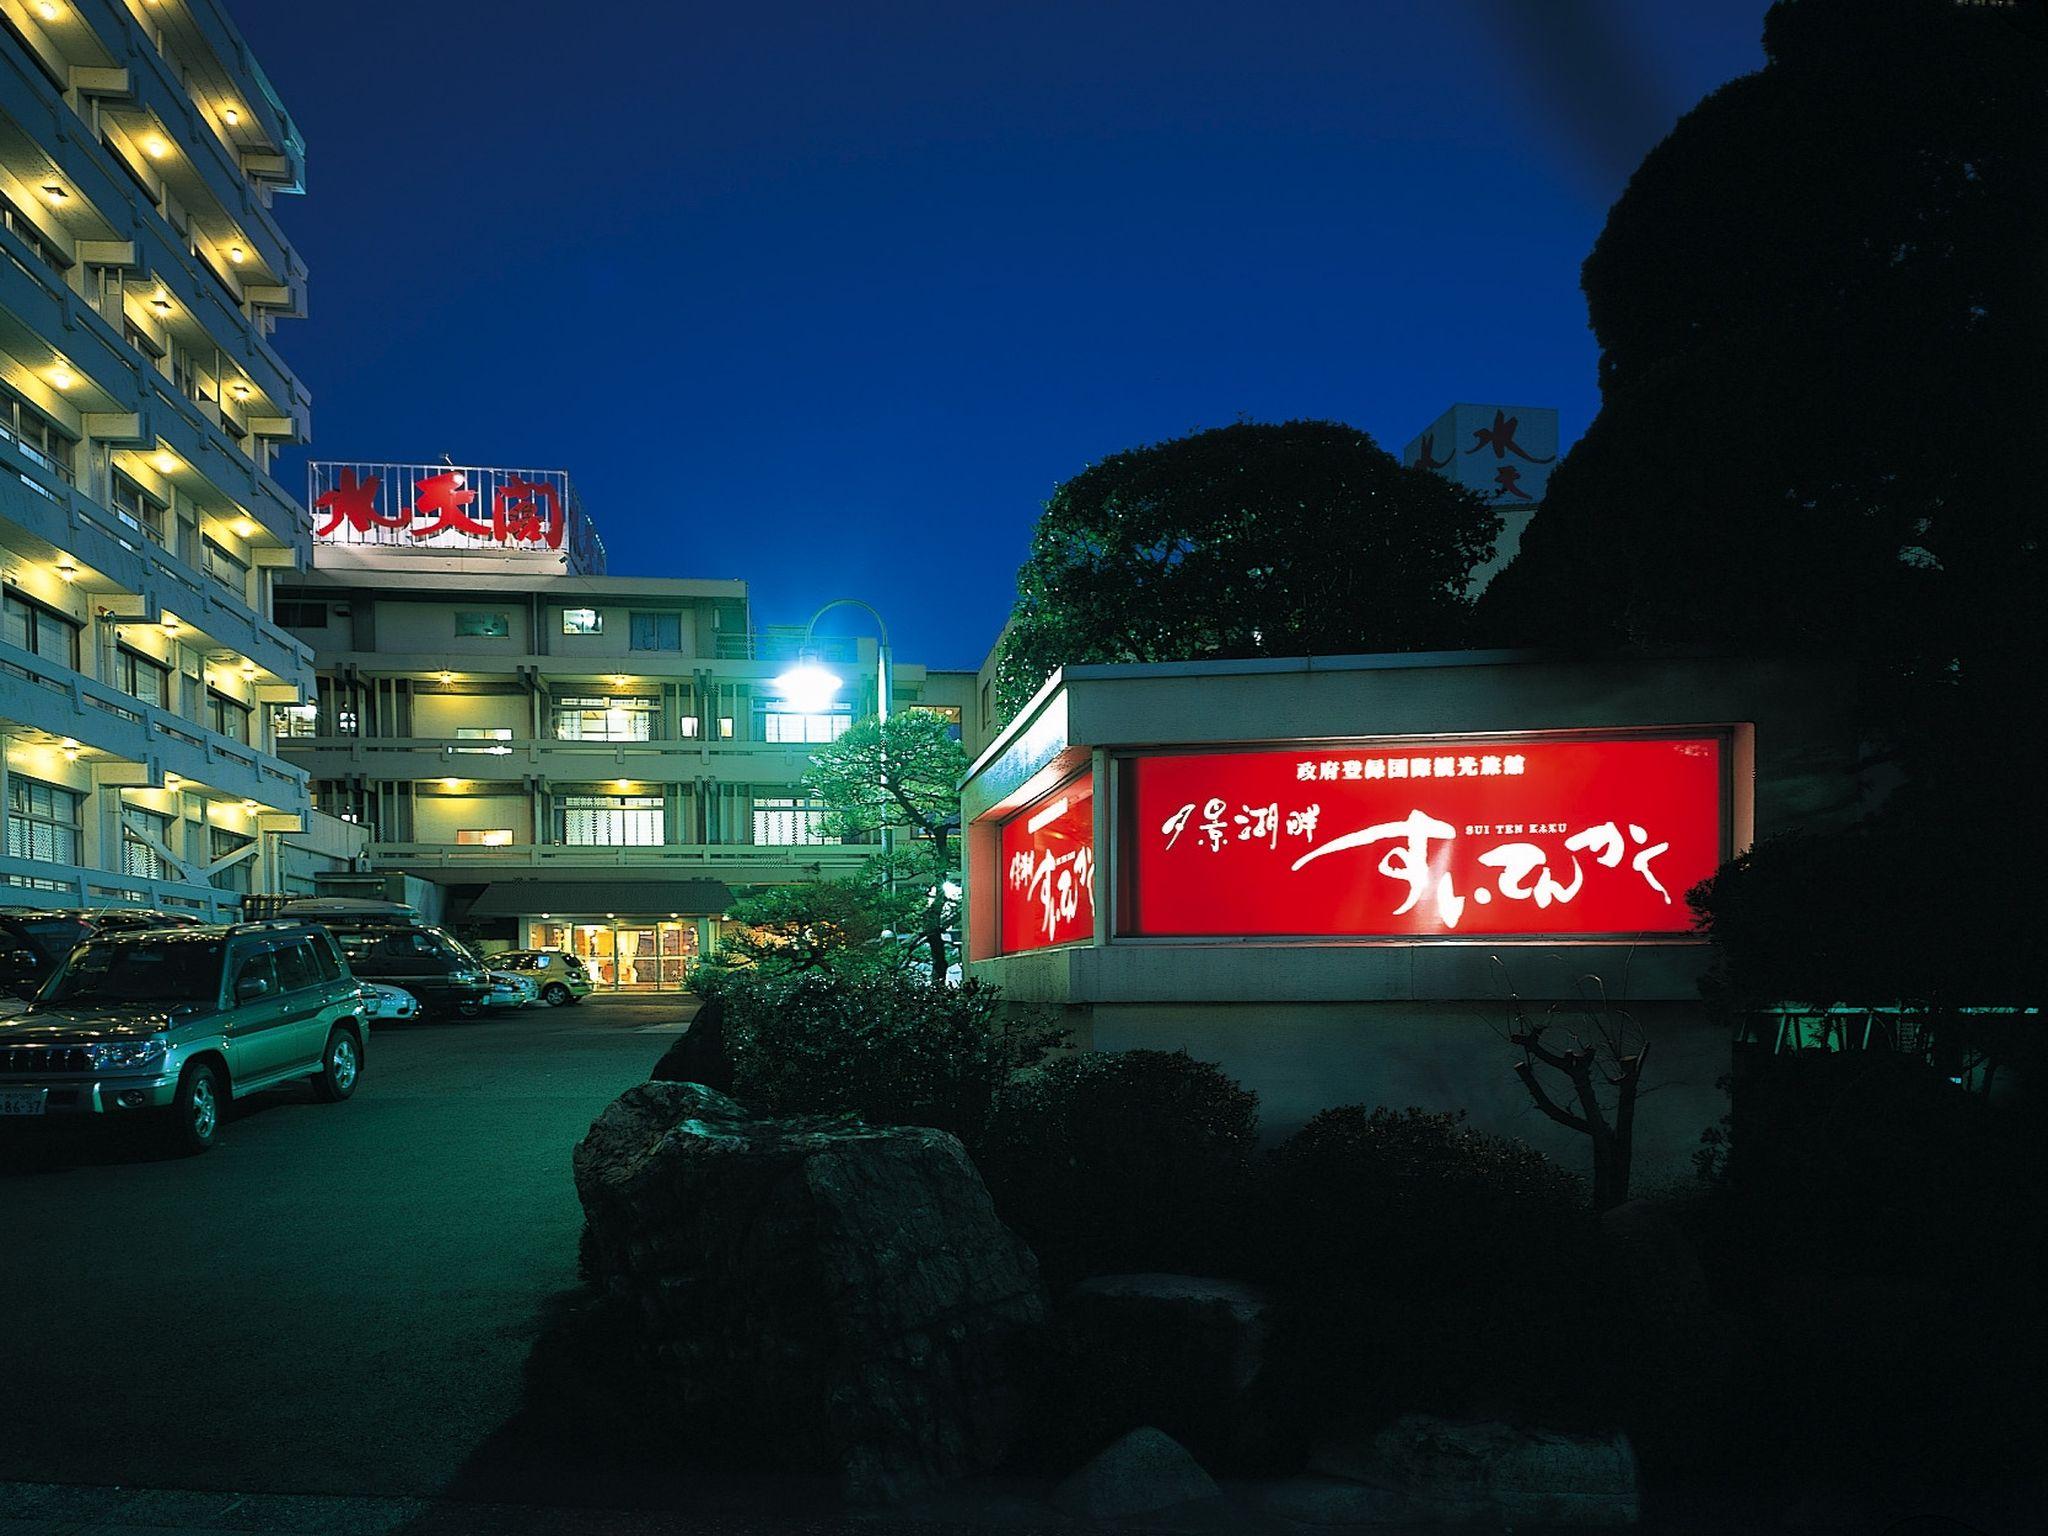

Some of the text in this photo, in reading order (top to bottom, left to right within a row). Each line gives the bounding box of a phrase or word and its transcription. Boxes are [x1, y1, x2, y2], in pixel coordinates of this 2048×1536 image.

[315, 466, 564, 549] 水天閣
[1161, 798, 1320, 853] 夕景湖畔
[1465, 823, 1567, 835] SUI TEN KAKU
